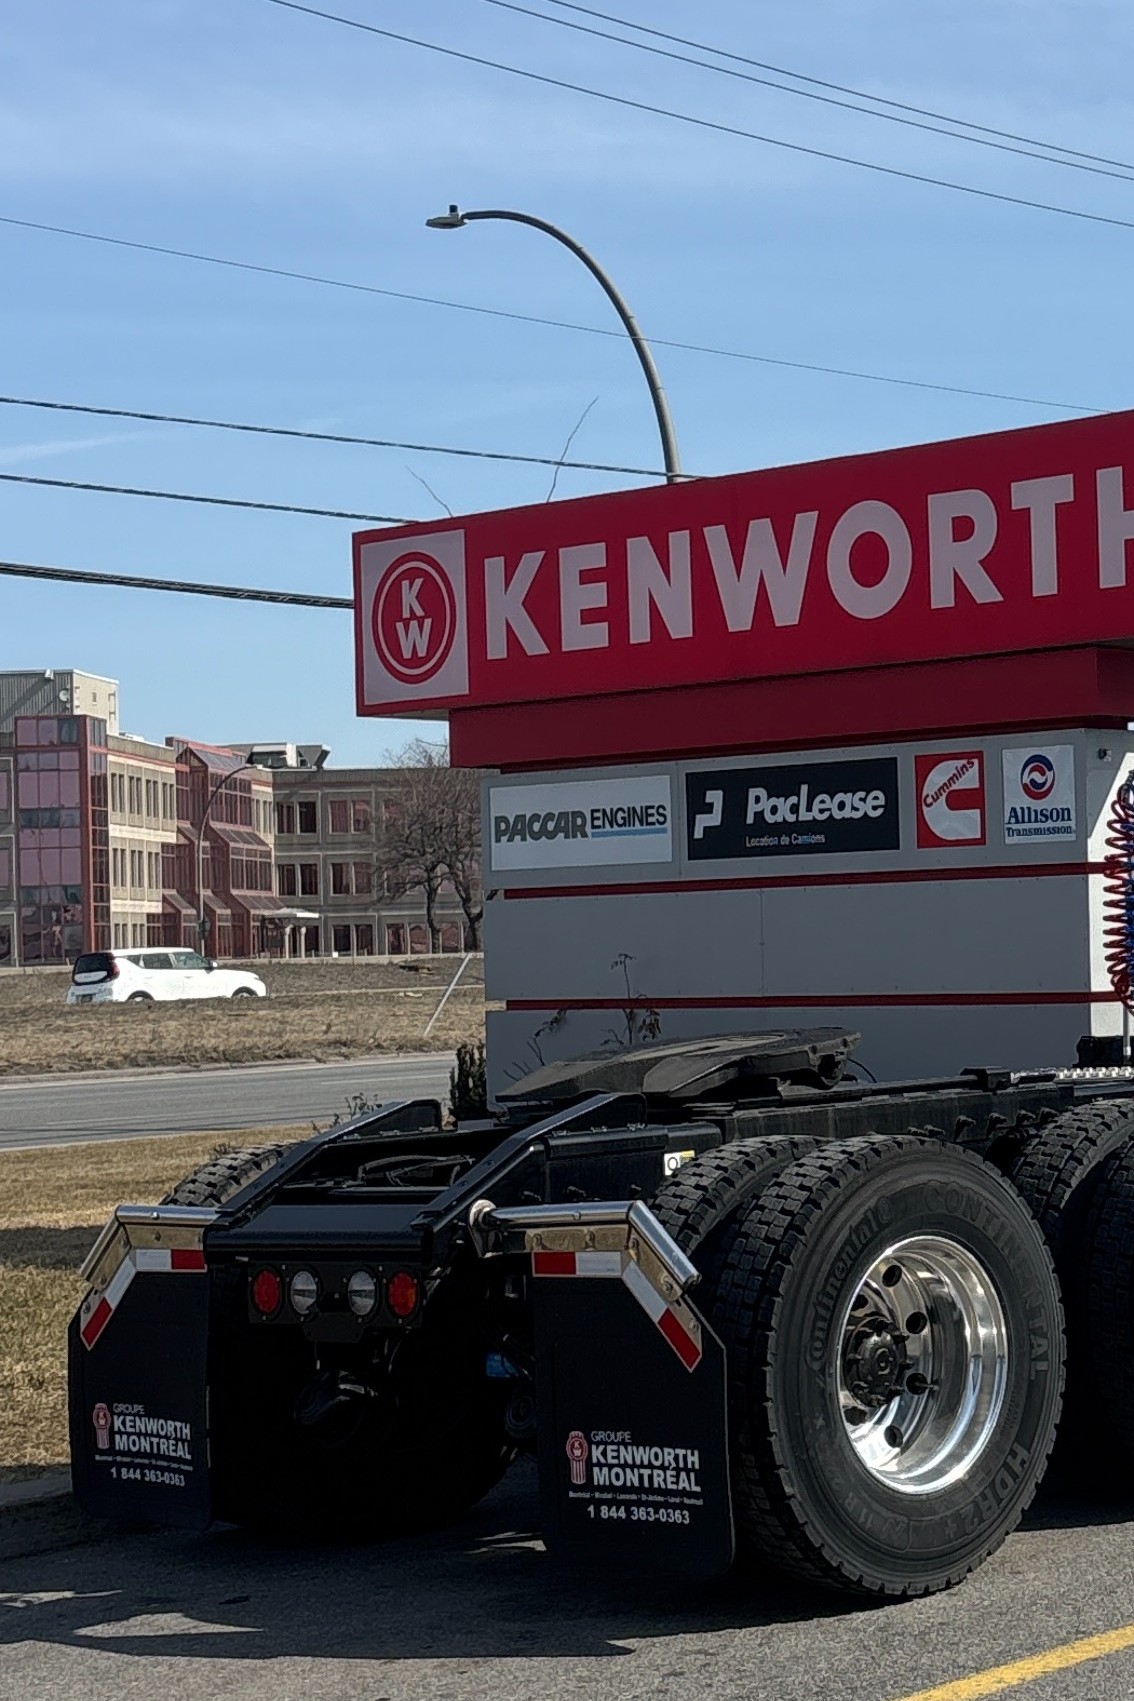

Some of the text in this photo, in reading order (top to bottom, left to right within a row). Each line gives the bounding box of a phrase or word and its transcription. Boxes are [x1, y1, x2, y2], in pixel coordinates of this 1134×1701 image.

[923, 759, 974, 808] Cummins
[745, 783, 886, 824] PacLease
[494, 804, 668, 843] PACCAR ENGINES
[1005, 806, 1072, 825] Allison
[746, 832, 826, 848] Location de Camions
[1006, 825, 1073, 838] Transmission
[113, 1403, 145, 1414] GROUPE
[113, 1415, 191, 1440] KENWORTH
[591, 1431, 632, 1443] GROUPE
[591, 1444, 700, 1470] KENWORTH
[110, 1467, 117, 1478] 1
[120, 1467, 141, 1480] 844
[587, 1504, 690, 1524] 1 844 363-0363
